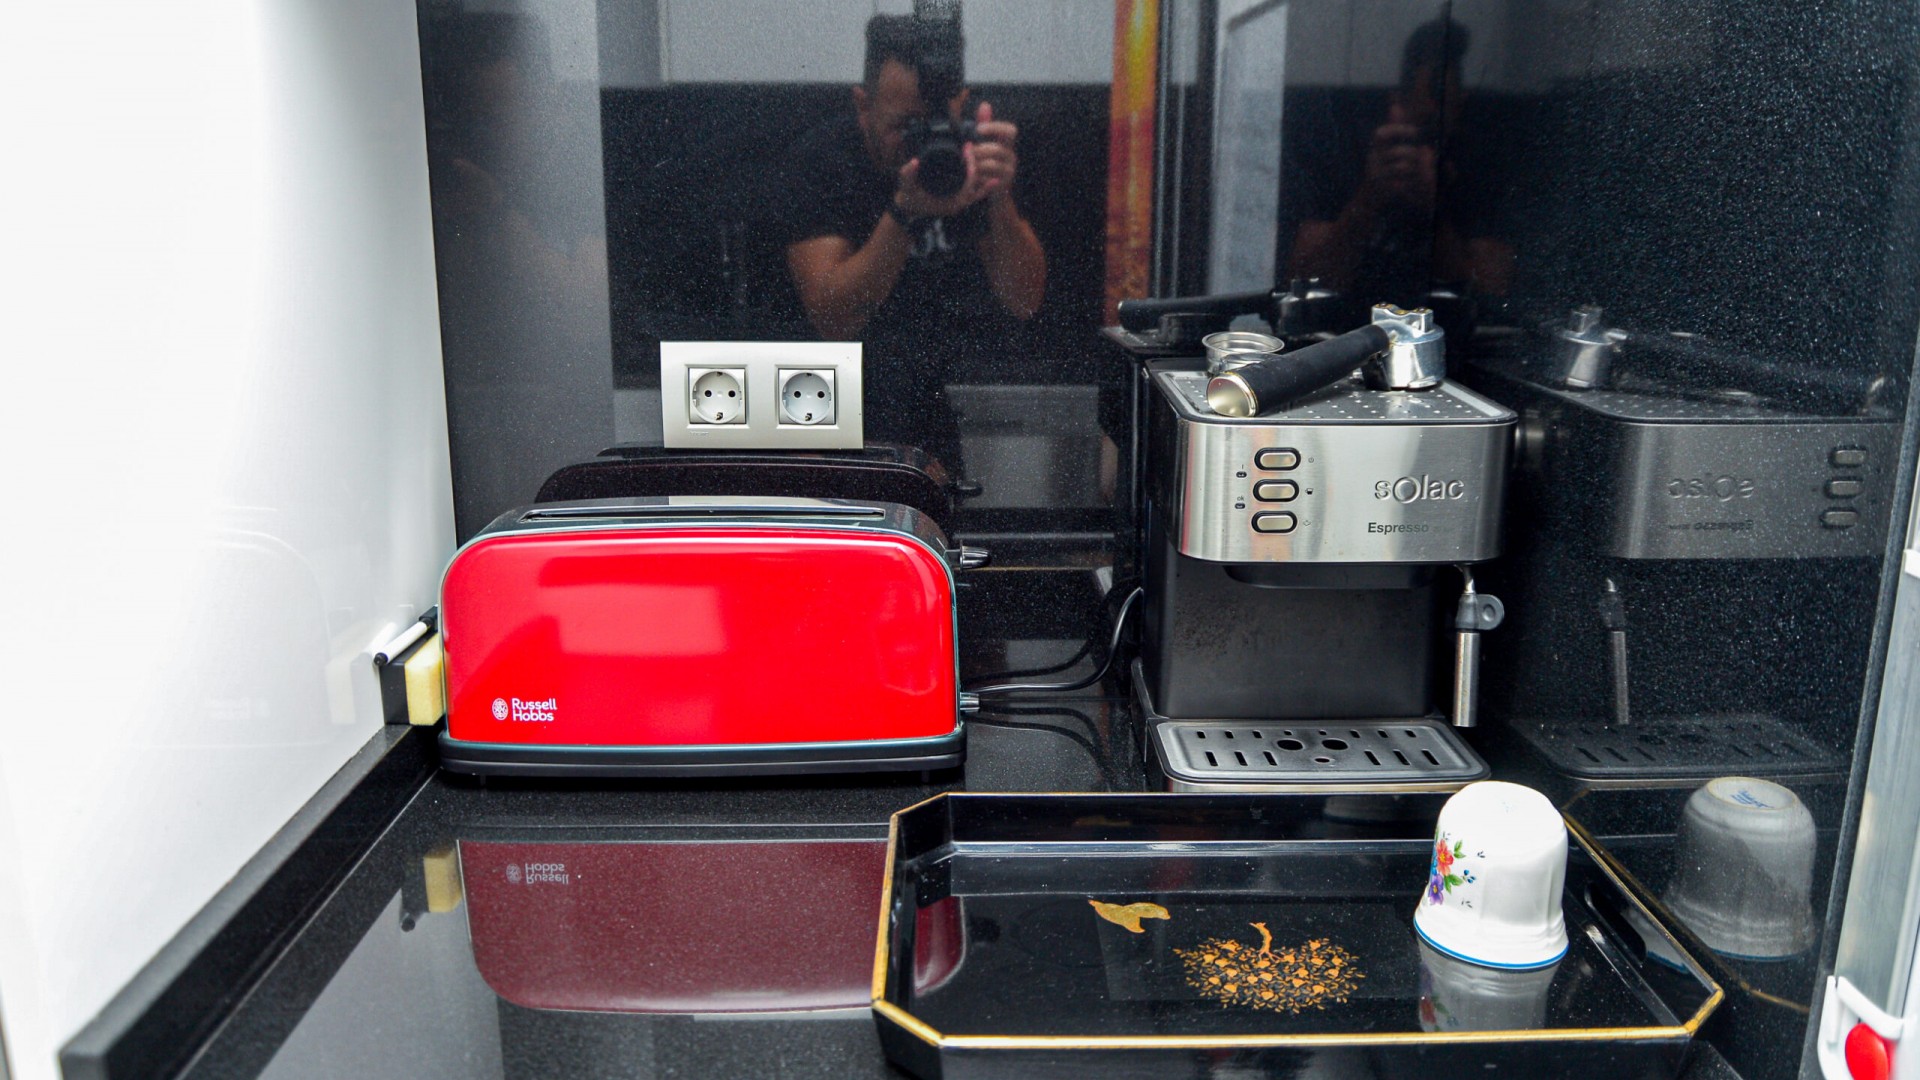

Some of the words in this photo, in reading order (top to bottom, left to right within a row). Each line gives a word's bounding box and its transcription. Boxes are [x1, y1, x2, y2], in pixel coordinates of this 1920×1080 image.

[1368, 522, 1430, 535] Espresso
[511, 697, 557, 710] Russell
[512, 709, 555, 721] Hobbs
